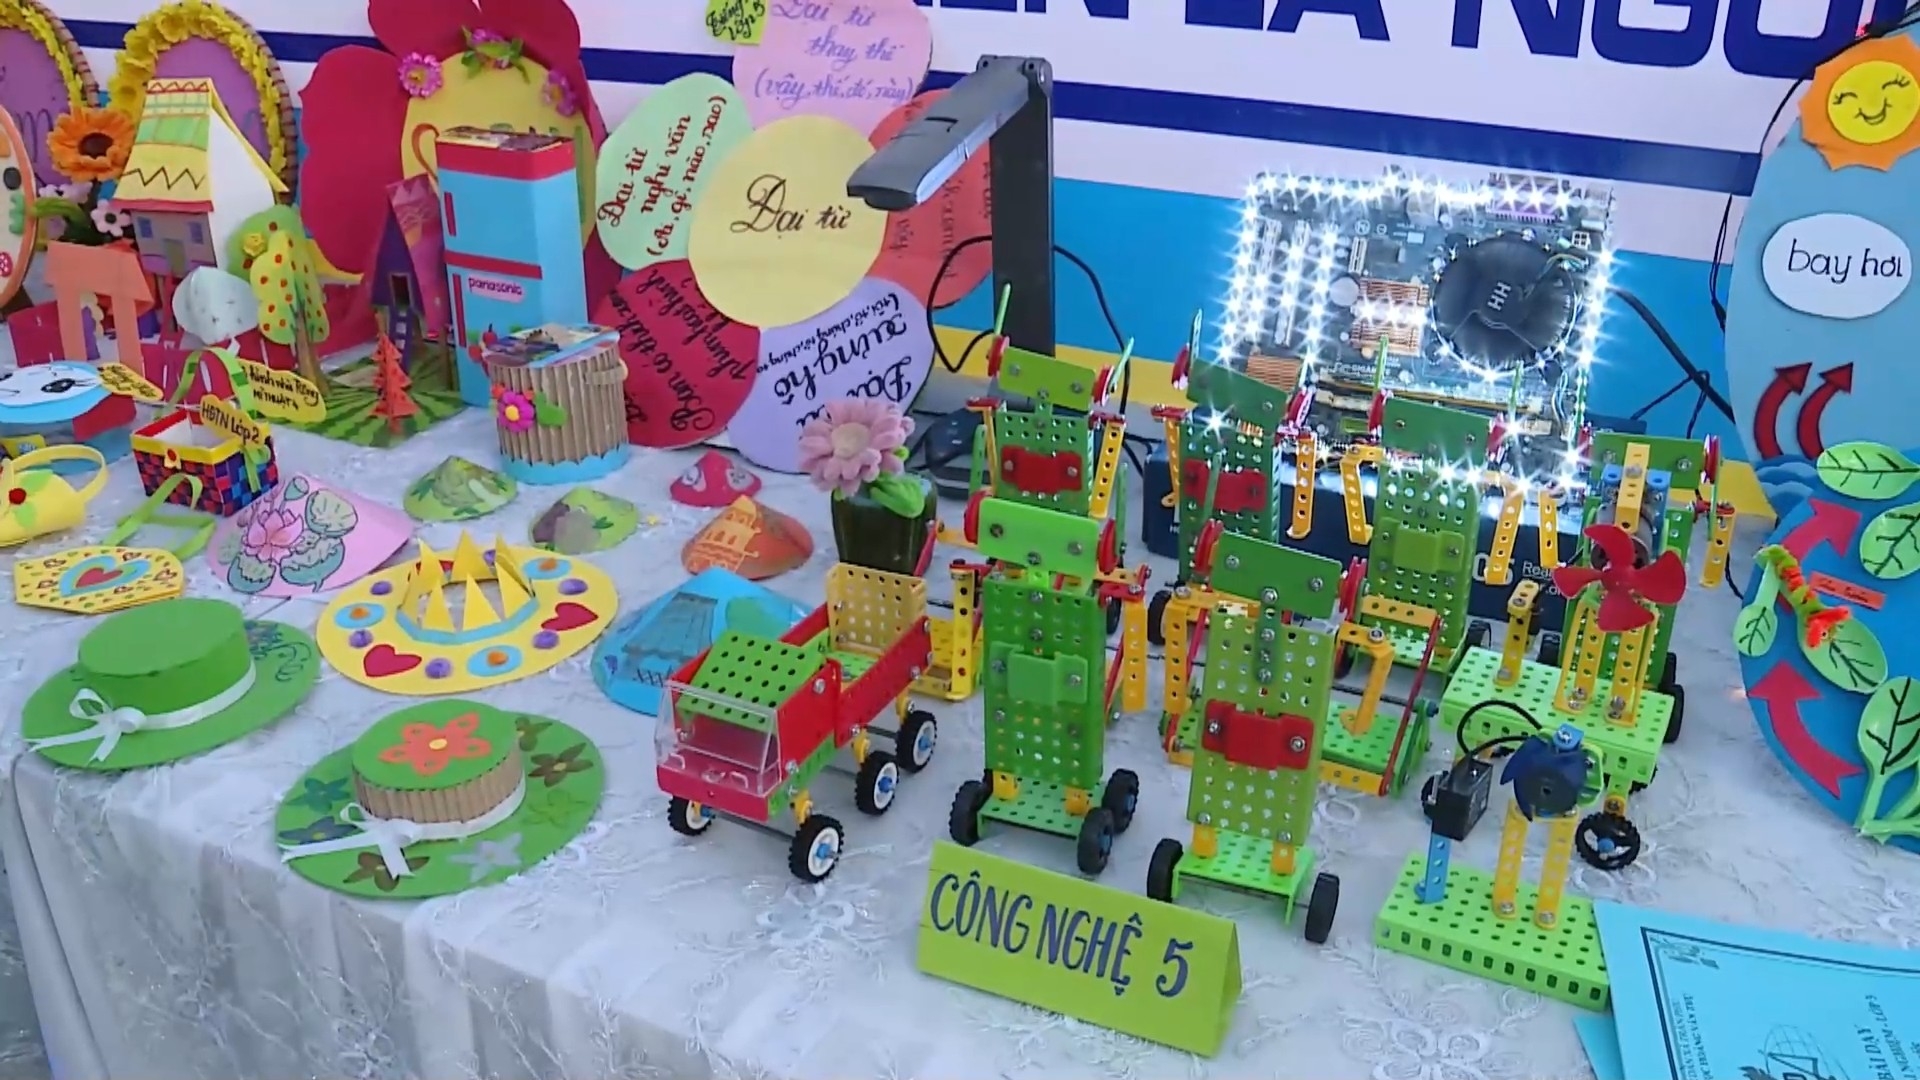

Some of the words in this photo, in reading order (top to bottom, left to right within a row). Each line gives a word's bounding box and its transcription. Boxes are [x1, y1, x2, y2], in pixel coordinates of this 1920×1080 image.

[730, 173, 809, 240] Đại
[814, 204, 852, 229] từ
[1787, 238, 1852, 284] bay
[251, 426, 260, 444] 2
[930, 870, 1033, 954] CÔNG
[1036, 903, 1143, 996] NGHỆ
[1155, 938, 1194, 998] 5
